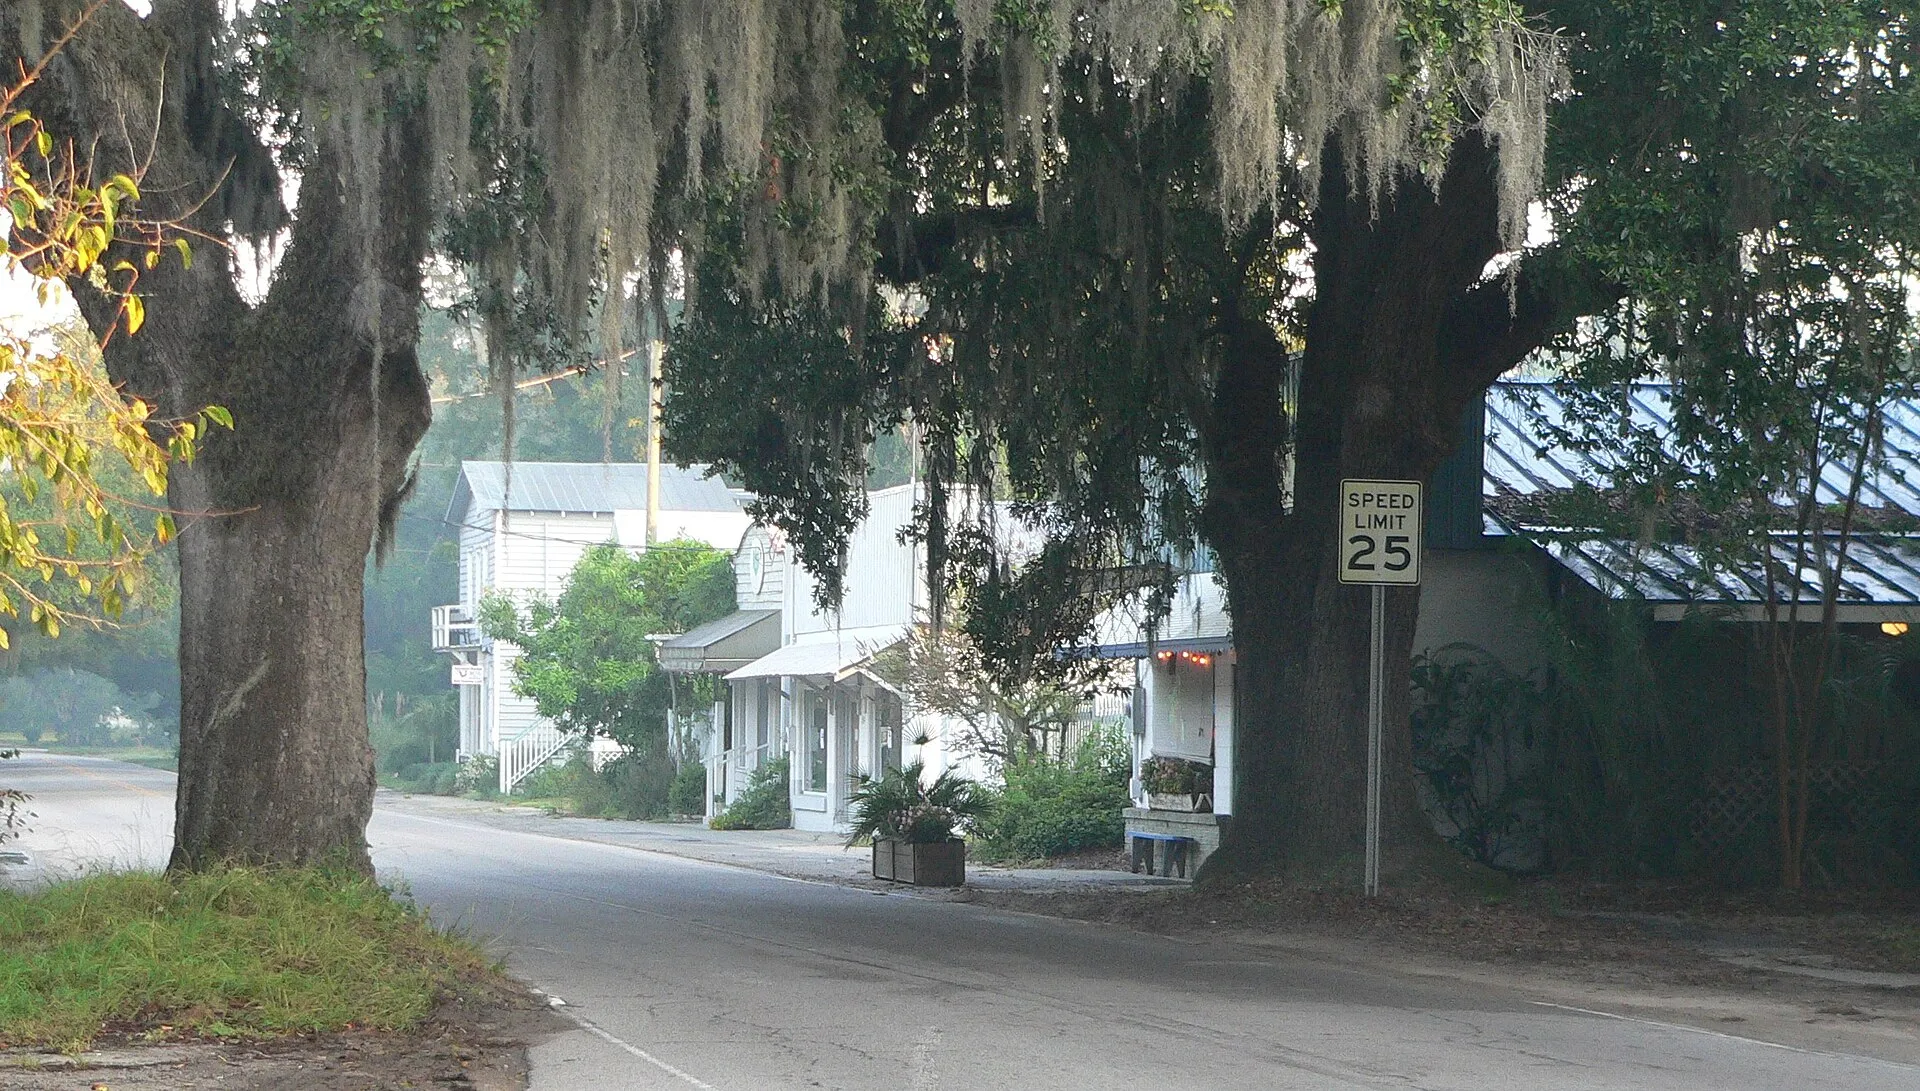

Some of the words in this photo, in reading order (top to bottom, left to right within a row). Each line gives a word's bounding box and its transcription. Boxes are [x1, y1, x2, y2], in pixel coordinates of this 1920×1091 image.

[1348, 492, 1414, 509] SPEED
[1355, 513, 1406, 530] LIMIT
[1347, 534, 1411, 571] 25
